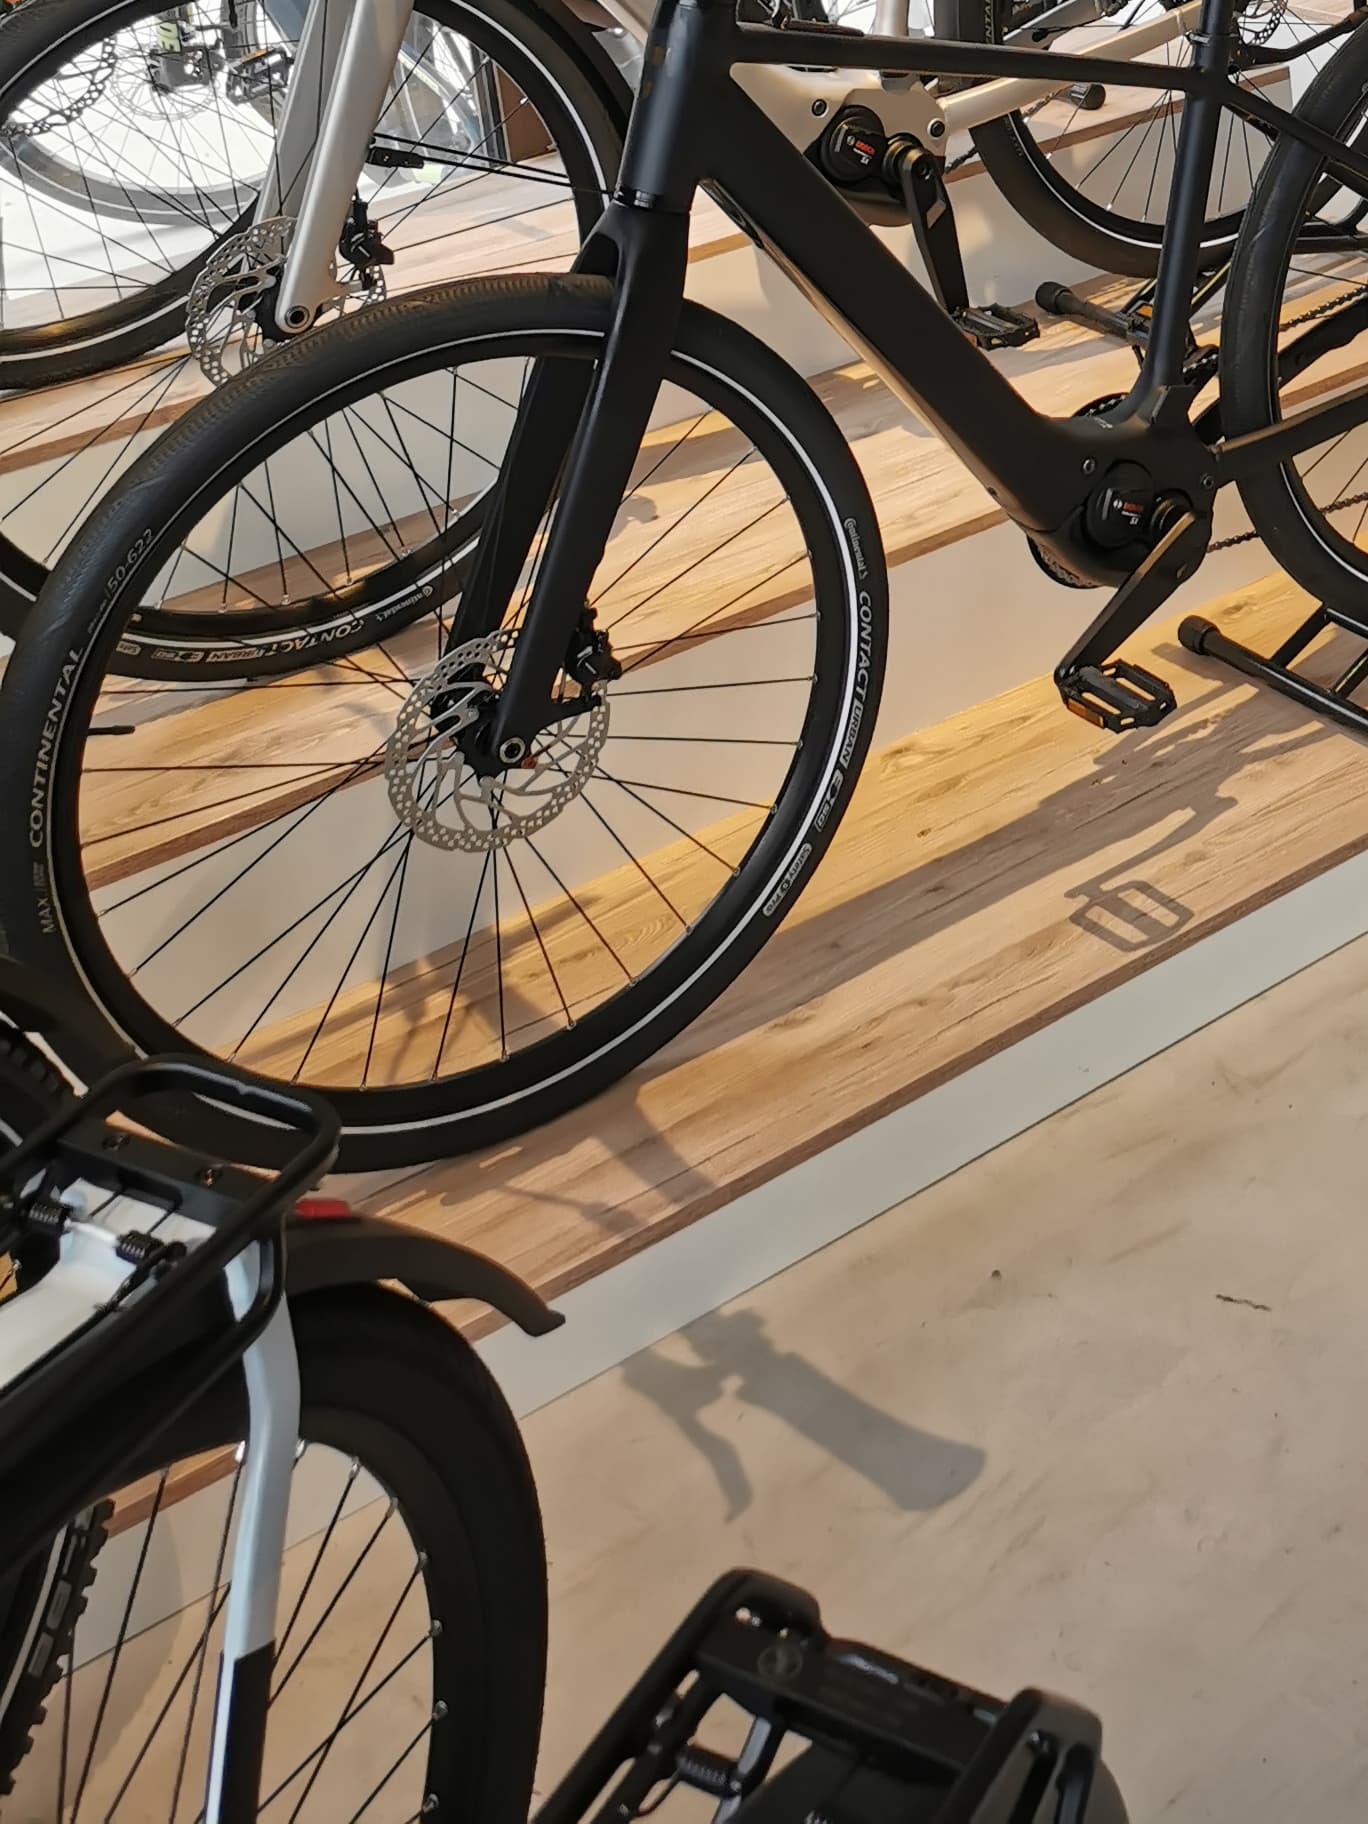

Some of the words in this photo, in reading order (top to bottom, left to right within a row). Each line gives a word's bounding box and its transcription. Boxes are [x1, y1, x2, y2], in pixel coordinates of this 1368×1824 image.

[107, 528, 154, 592] 50-622
[843, 518, 867, 574] Continental
[206, 646, 264, 664] URBAN
[264, 619, 365, 656] CONTACT
[855, 591, 872, 702] CONTACT
[29, 647, 85, 849] CONTINENTAL
[840, 703, 863, 769] URBAN
[37, 895, 57, 935] MAX
